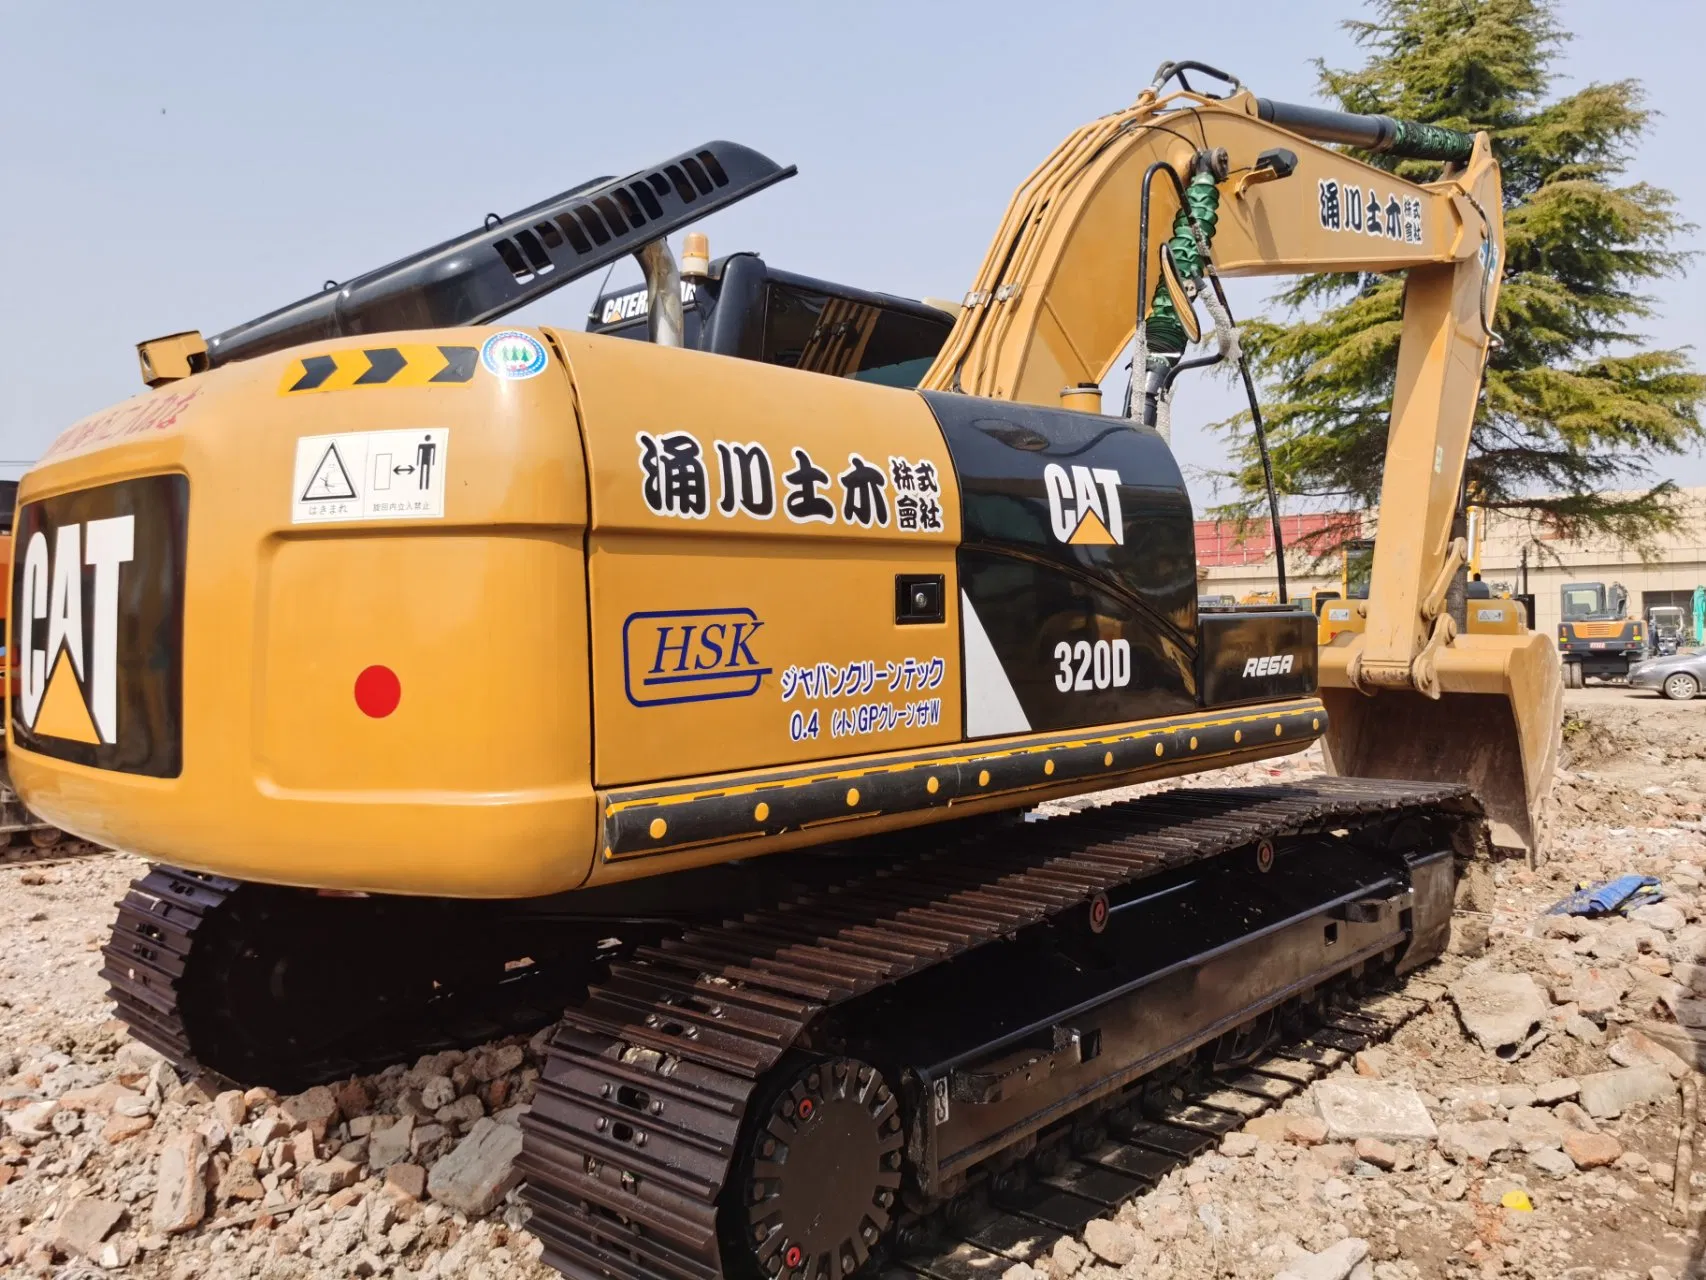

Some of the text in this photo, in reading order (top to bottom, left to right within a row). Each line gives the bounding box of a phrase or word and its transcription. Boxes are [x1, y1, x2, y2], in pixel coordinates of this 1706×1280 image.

[1044, 463, 1124, 545] CAT
[21, 515, 134, 744] CAT
[648, 622, 764, 673] HSK
[1054, 639, 1130, 692] 320D
[790, 711, 820, 741] 0.4
